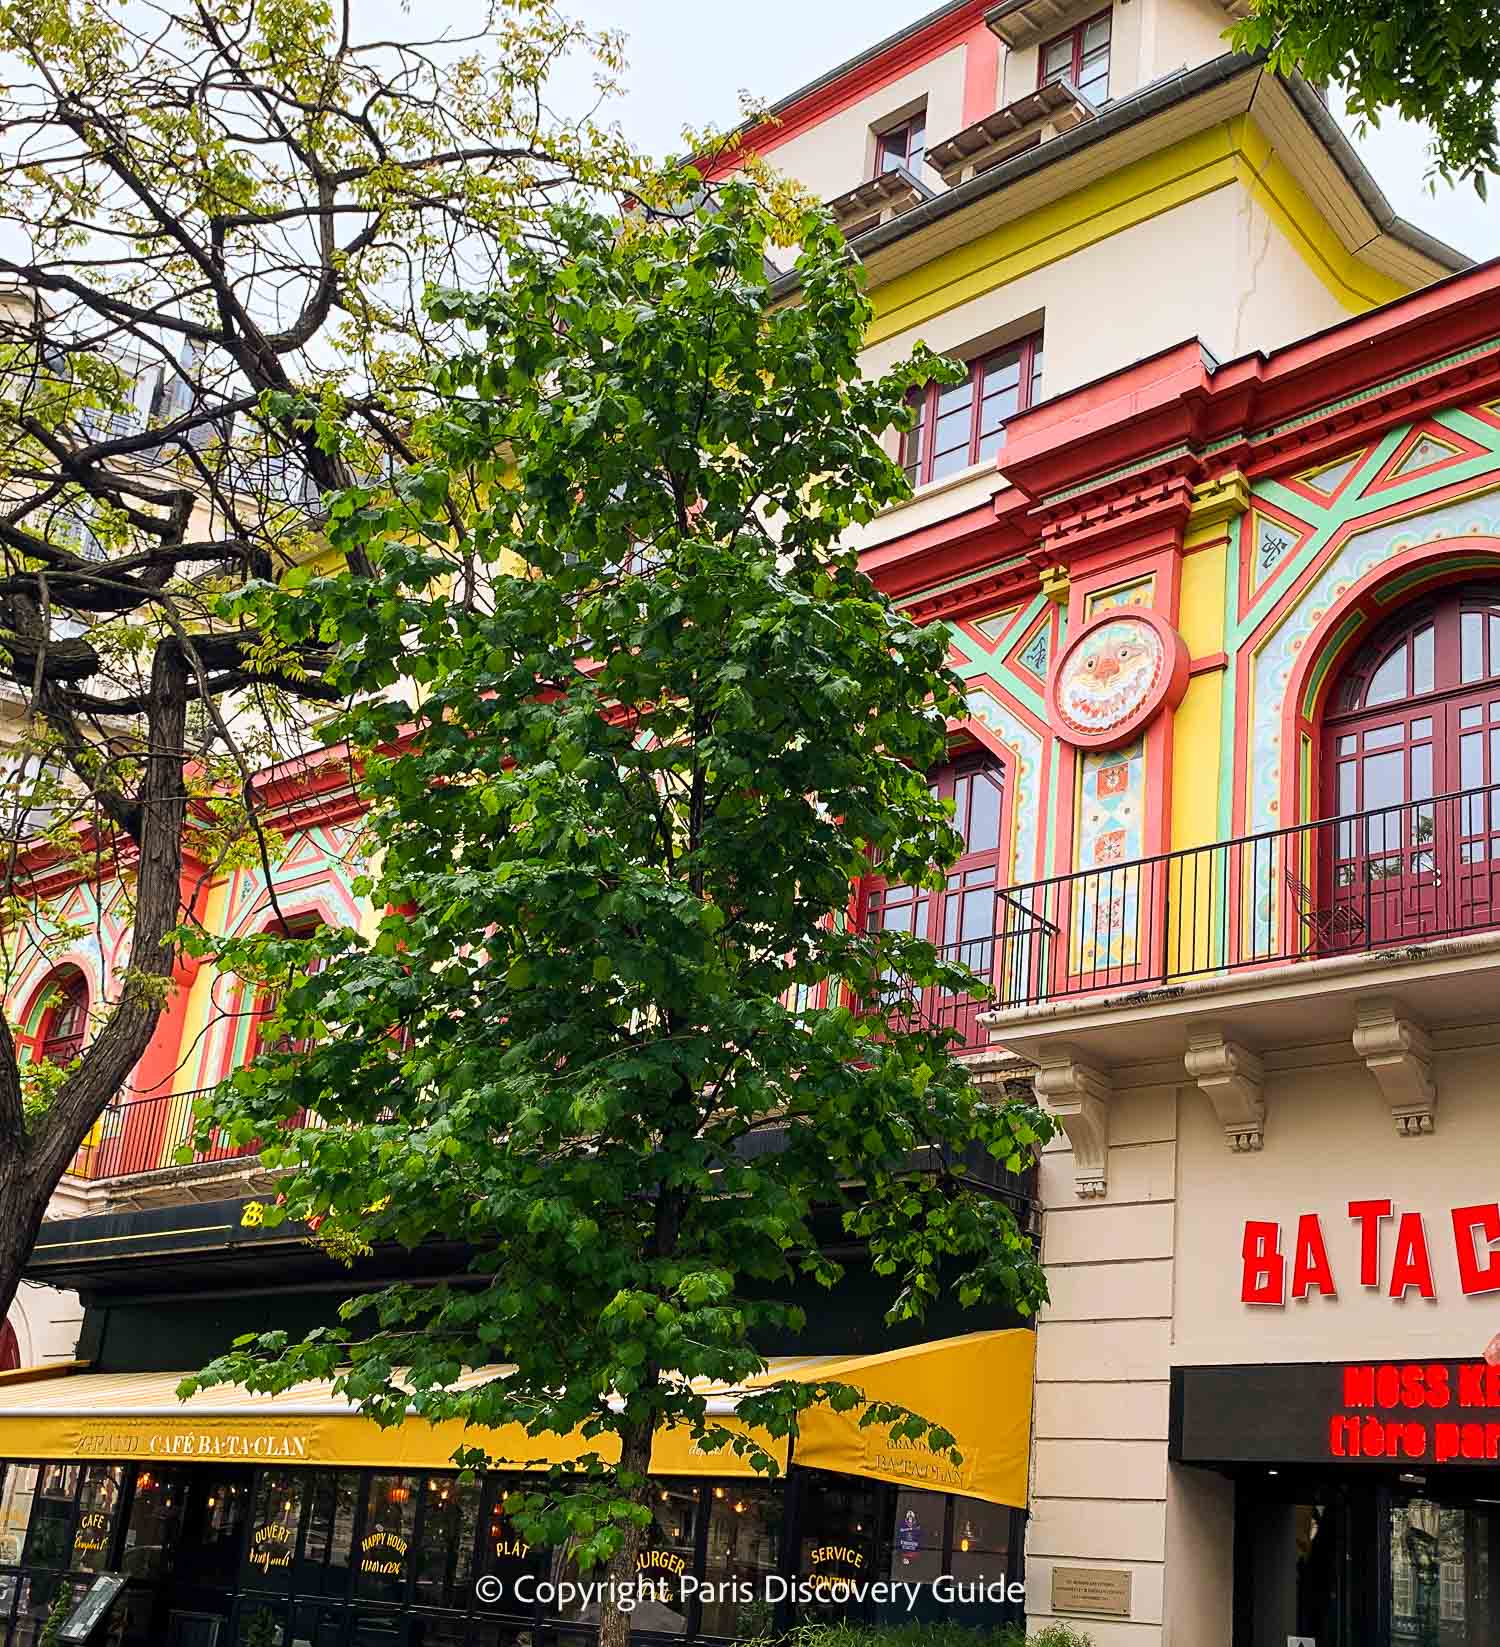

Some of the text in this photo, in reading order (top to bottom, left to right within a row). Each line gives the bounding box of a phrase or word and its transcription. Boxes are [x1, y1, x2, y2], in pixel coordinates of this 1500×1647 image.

[1343, 1365, 1450, 1409] MOSS
[150, 1432, 194, 1454] CAFÉ
[255, 1524, 291, 1544] OUVERT
[361, 1532, 408, 1557] HAPPY HOUR
[496, 1540, 530, 1559] PLAT
[811, 1546, 863, 1568] SERVICE
